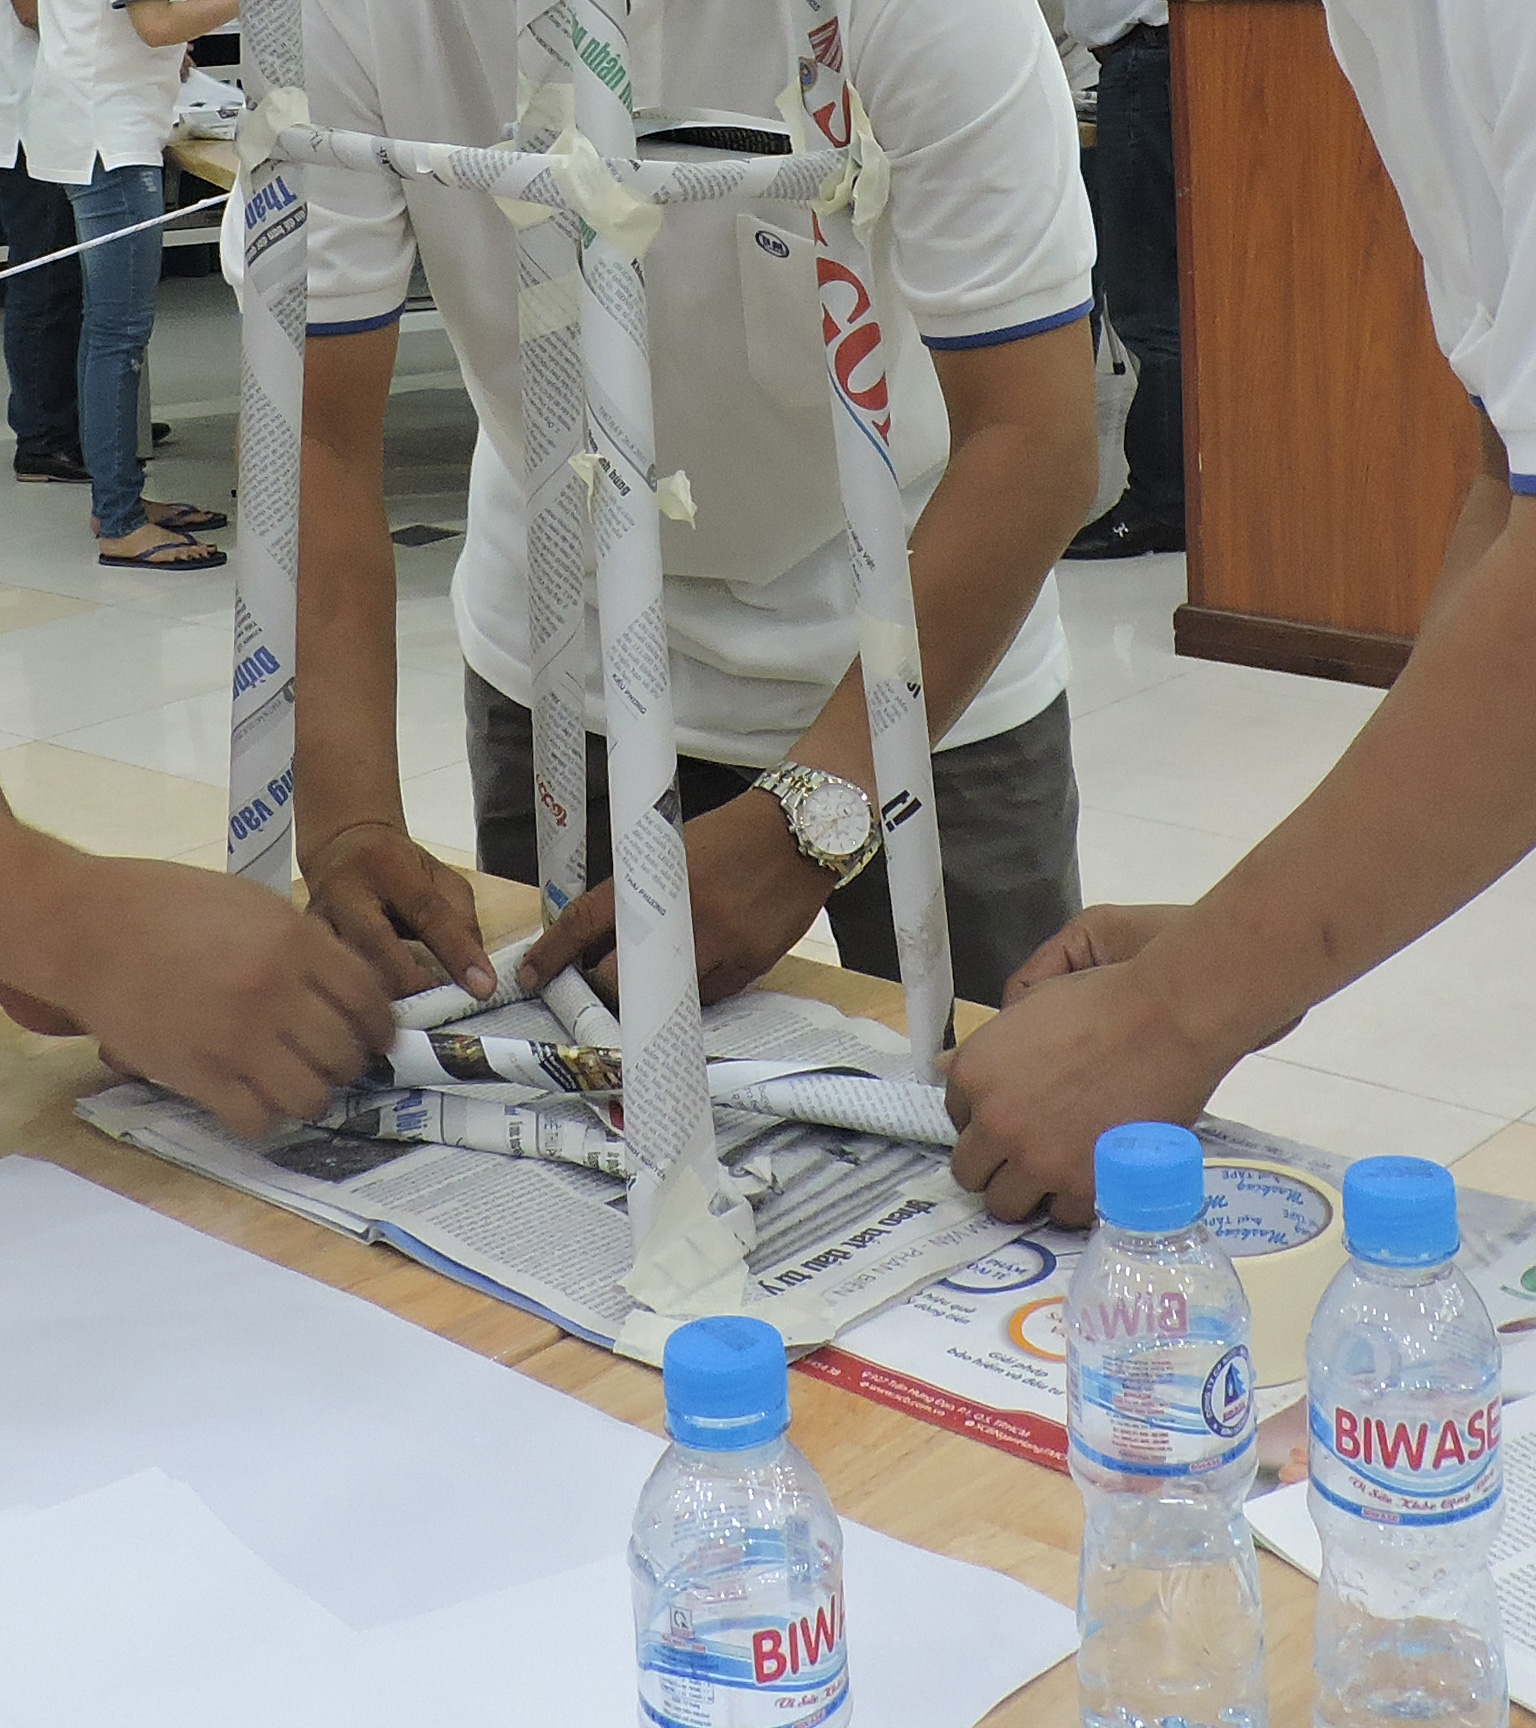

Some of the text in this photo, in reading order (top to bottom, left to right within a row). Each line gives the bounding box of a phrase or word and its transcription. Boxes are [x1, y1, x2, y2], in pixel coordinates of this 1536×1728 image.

[229, 797, 273, 840] vào
[1335, 1395, 1501, 1471] BIWASE
[753, 1579, 845, 1684] BIW
